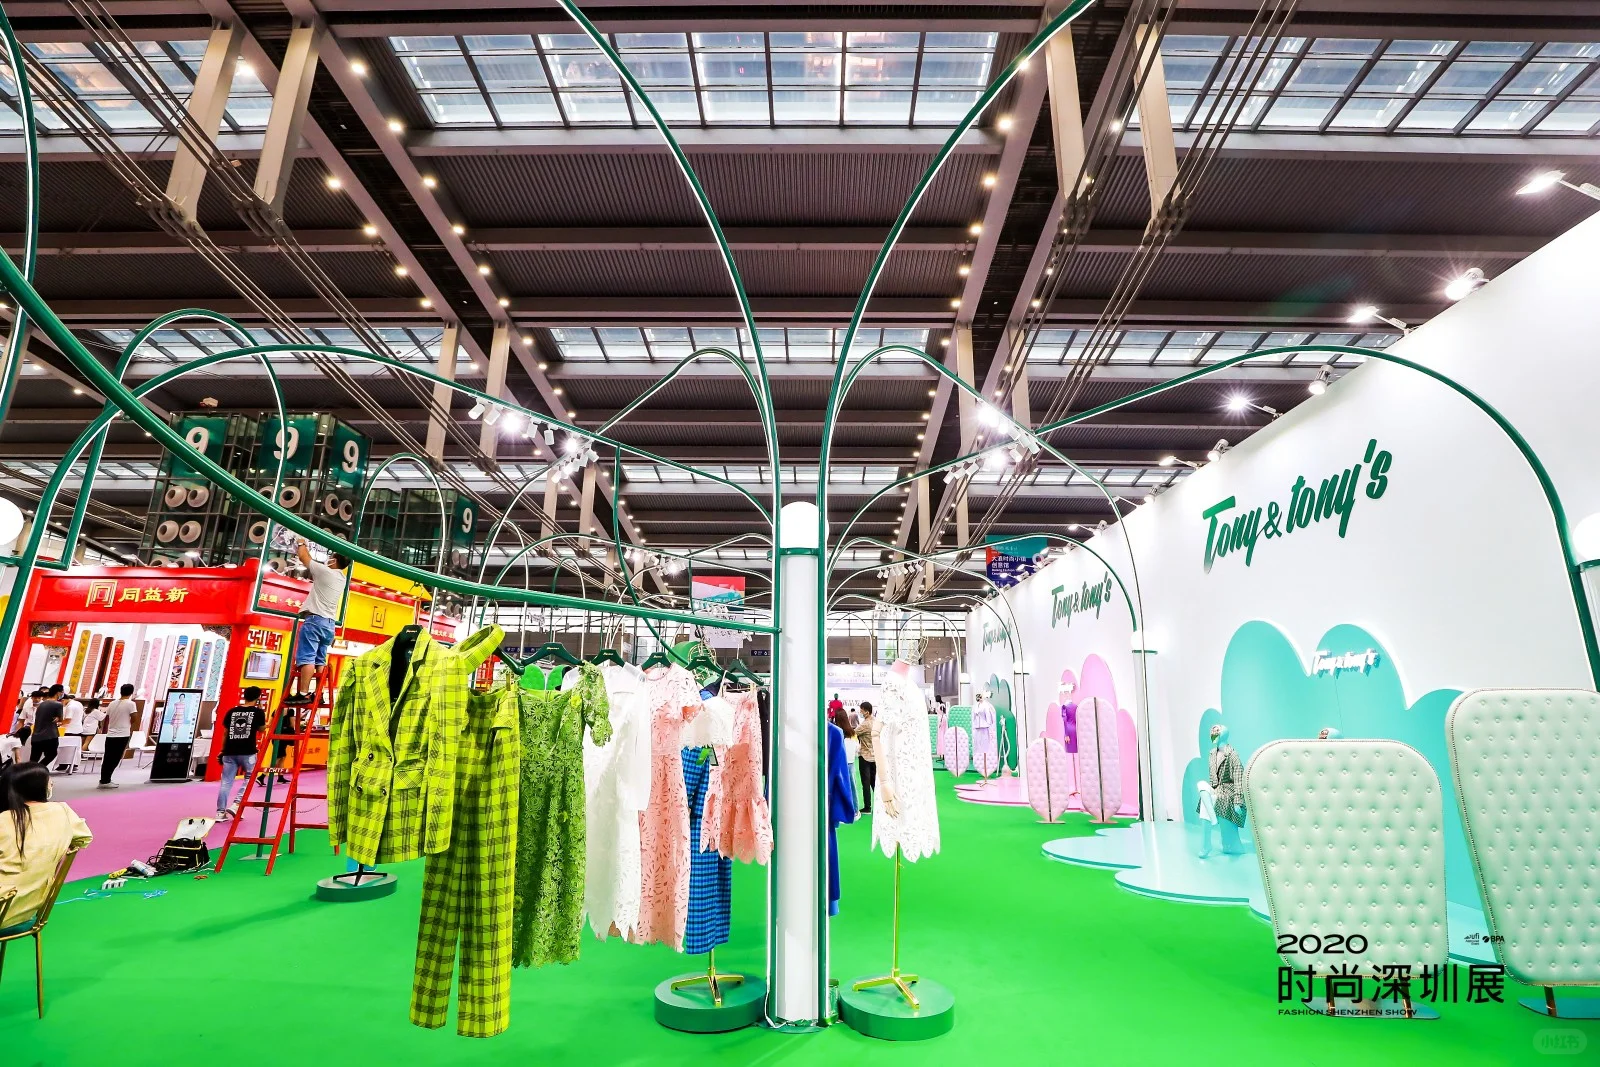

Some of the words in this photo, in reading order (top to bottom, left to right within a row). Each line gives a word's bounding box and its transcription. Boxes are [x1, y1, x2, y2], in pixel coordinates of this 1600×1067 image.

[184, 426, 209, 455] 9
[273, 426, 300, 460] 9
[341, 440, 360, 473] 9
[461, 507, 473, 534] 9
[117, 586, 189, 603] 同益新
